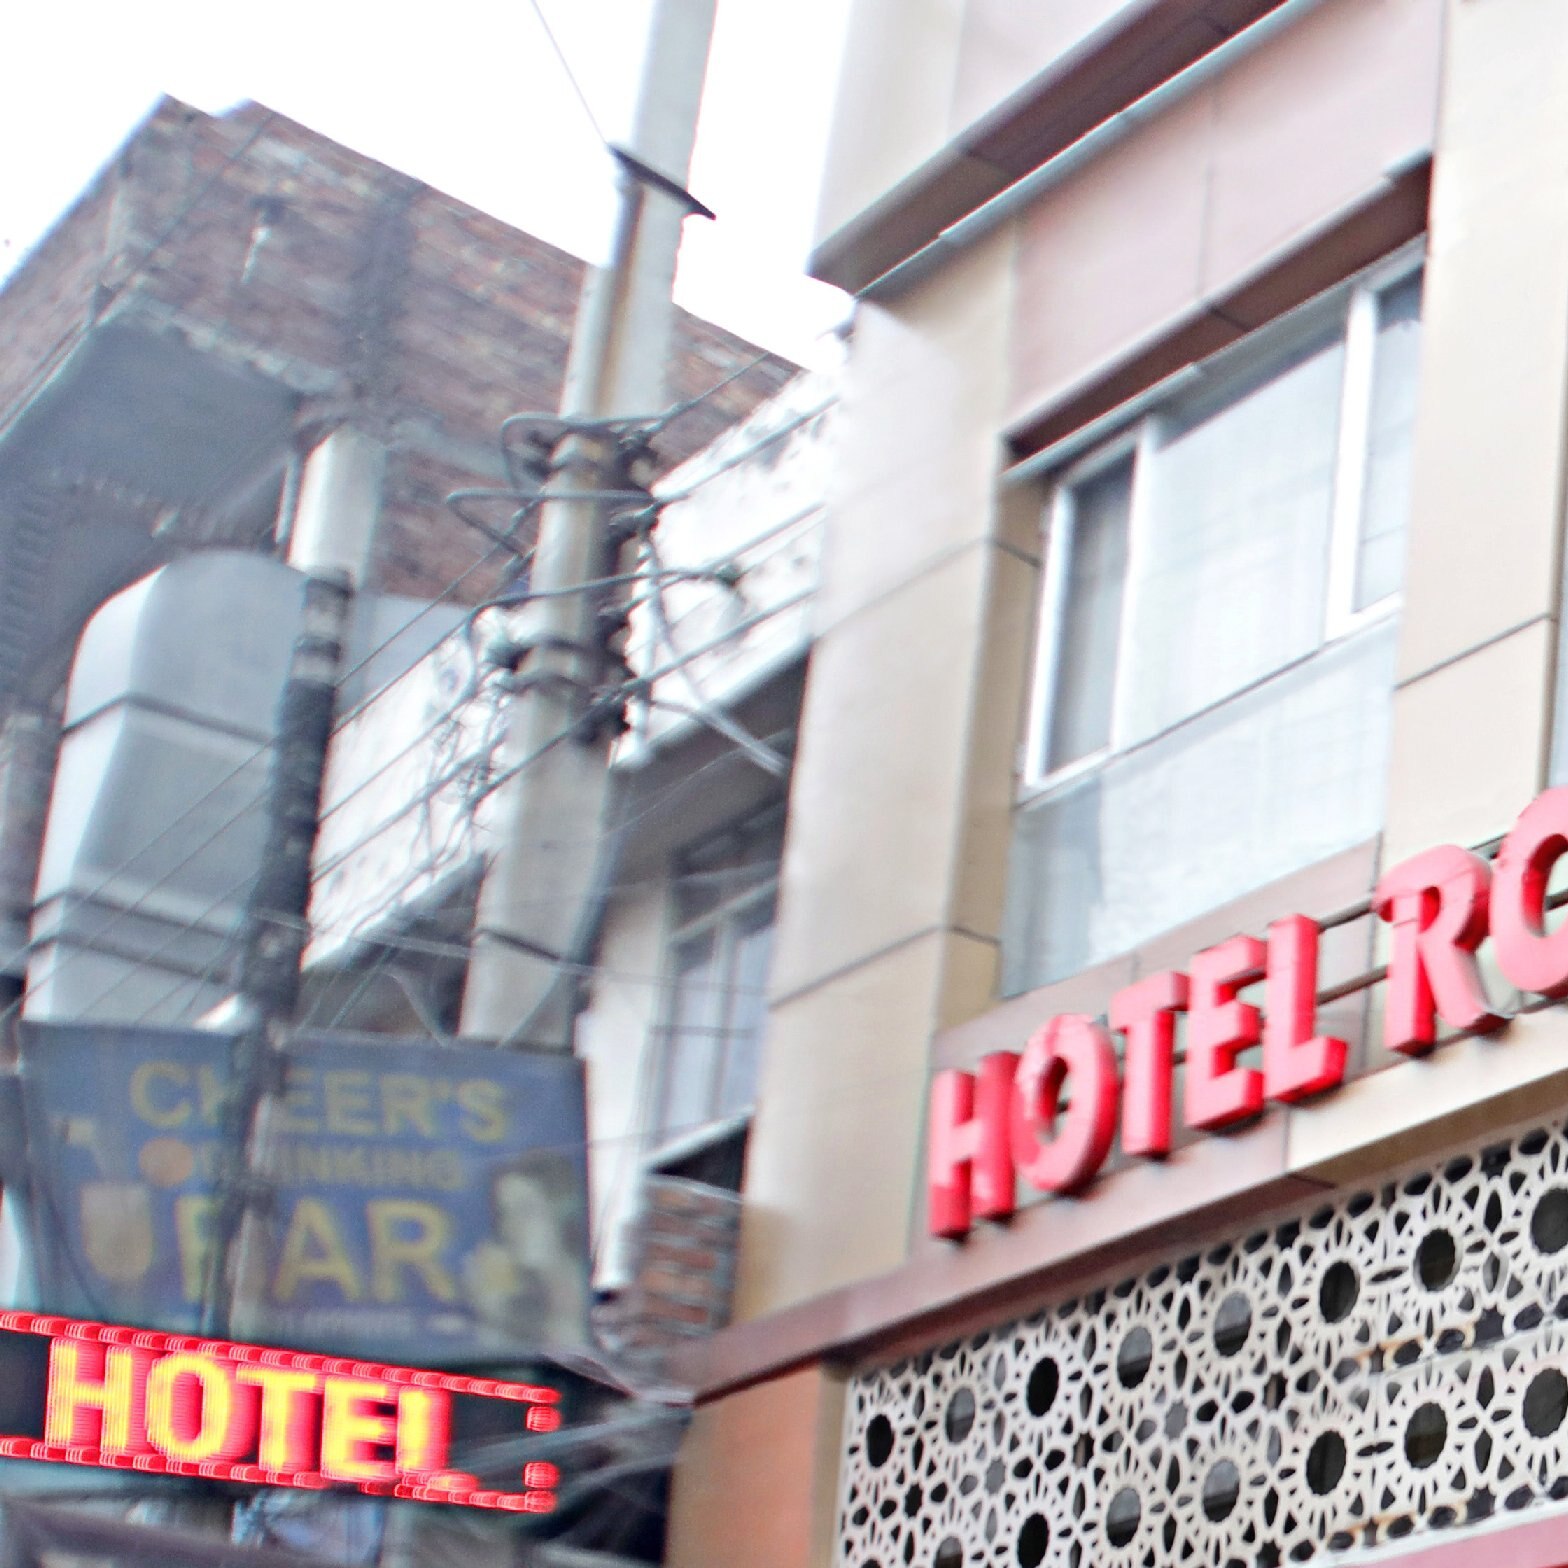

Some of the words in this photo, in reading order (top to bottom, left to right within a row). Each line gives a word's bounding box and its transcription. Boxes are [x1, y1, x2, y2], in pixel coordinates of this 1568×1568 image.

[130, 1060, 512, 1143] CEER'S
[928, 913, 1348, 1240] HOTEL
[45, 1335, 480, 1491] HOTEL
